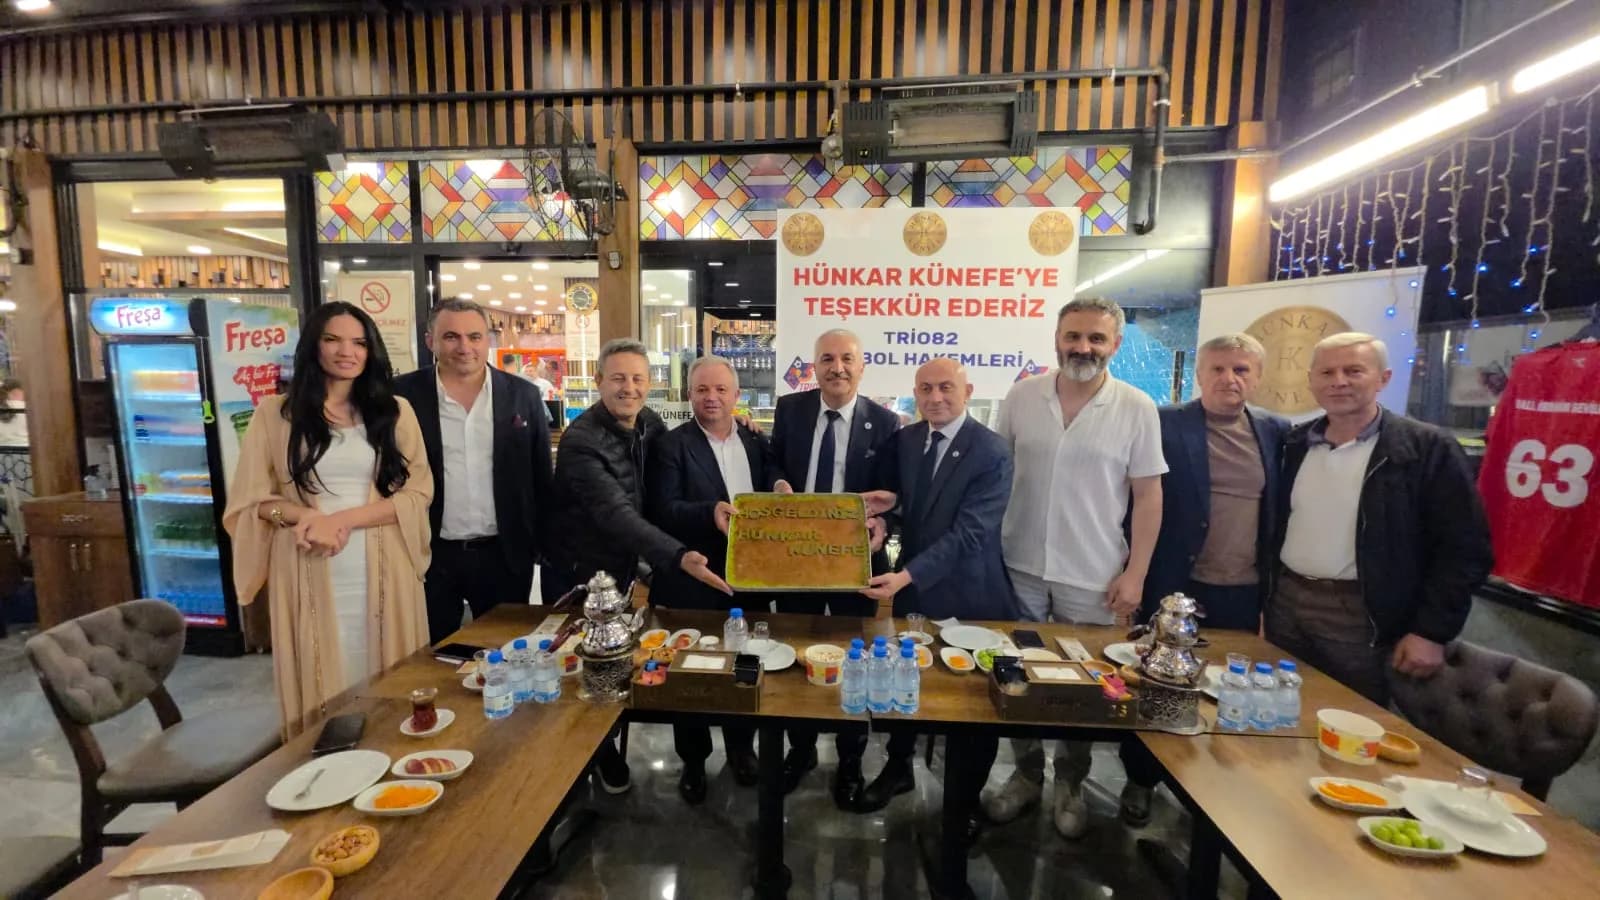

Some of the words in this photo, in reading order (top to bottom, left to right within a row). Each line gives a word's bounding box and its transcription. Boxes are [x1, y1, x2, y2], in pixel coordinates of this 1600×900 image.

[793, 263, 901, 286] HÜNKAR
[909, 262, 1058, 287] KÜNEFE'YE
[116, 304, 161, 328] Freşa
[804, 293, 940, 320] TEŞEKKÜR
[947, 294, 1045, 318] EDERİZ
[225, 321, 286, 352] Freşa
[1505, 439, 1594, 508] 63
